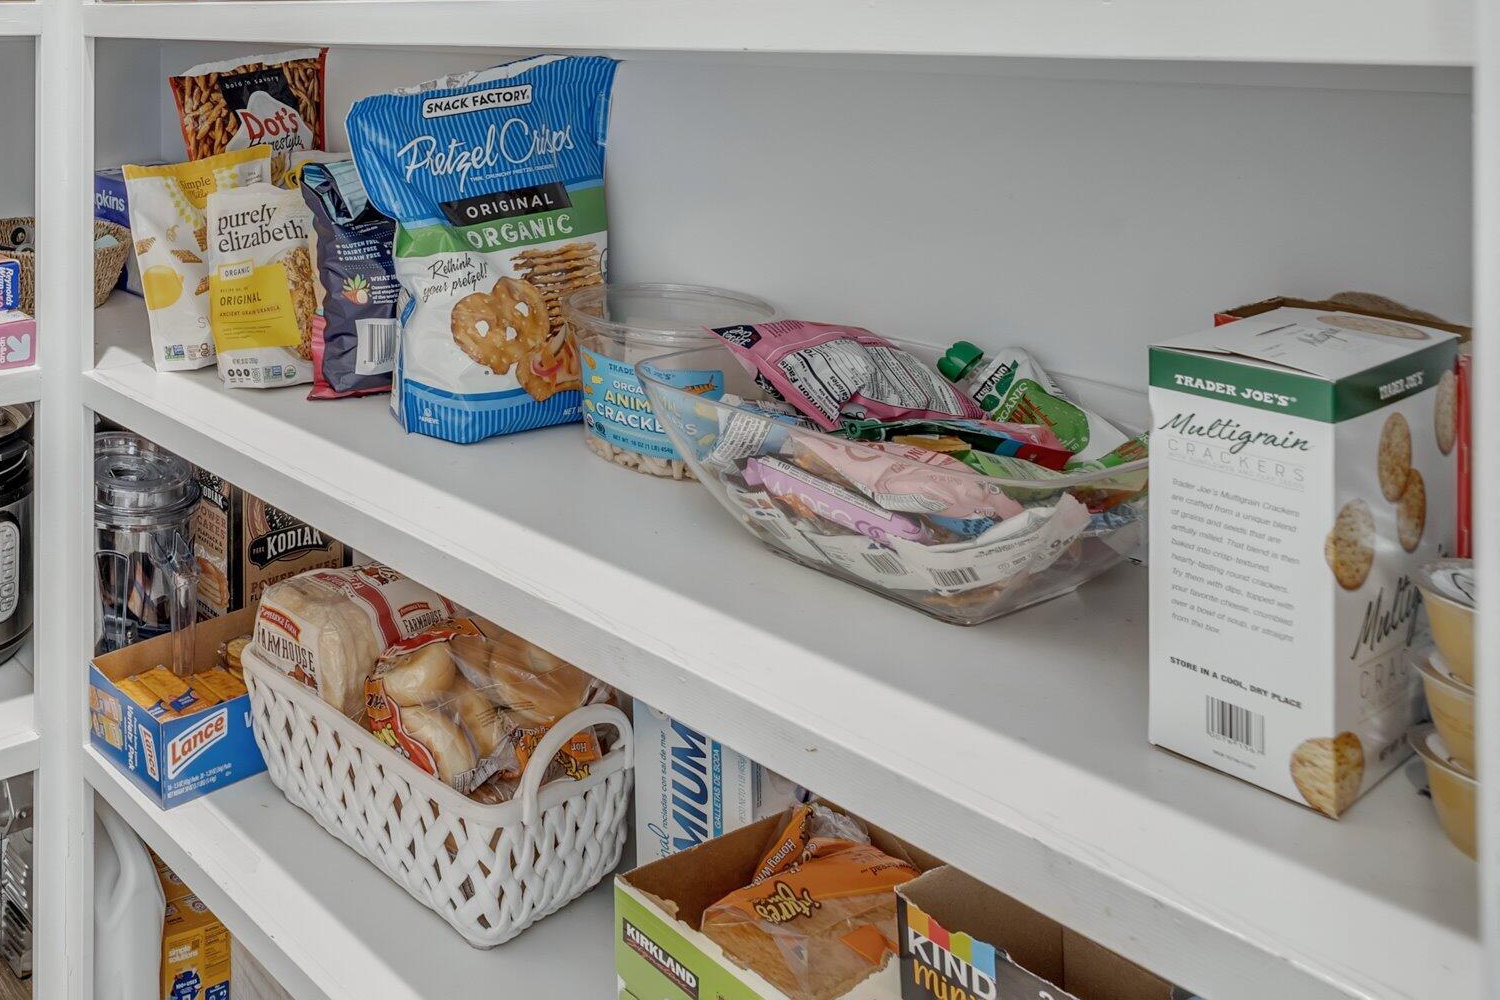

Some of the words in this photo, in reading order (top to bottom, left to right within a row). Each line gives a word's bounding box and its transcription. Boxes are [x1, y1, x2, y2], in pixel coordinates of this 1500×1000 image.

[254, 75, 279, 85] savory
[426, 98, 469, 114] SNACK
[472, 88, 529, 107] FACTORY
[240, 107, 299, 140] Dot's
[397, 123, 499, 193] Pretzel
[499, 117, 575, 168] Crisps
[217, 203, 277, 236] purely
[466, 193, 554, 219] ORIGINAL
[218, 219, 309, 253] elizabeth.
[341, 241, 365, 249] GLUTEN
[466, 213, 574, 249] ORGANIC
[342, 248, 362, 256] DAIRY
[428, 252, 476, 280] Rethink
[5, 267, 14, 306] Reynolds
[224, 266, 250, 278] ORGANIC
[422, 279, 450, 302] your
[450, 263, 488, 296] pretzel!
[219, 292, 262, 306] ORIGINAL
[256, 305, 280, 313] GRANOLA
[1174, 374, 1238, 396] TRADER
[1241, 388, 1291, 407] JOE'S
[1158, 412, 1310, 455] Multigrain
[777, 461, 790, 471] 110
[1167, 438, 1306, 482] CRACKERS
[266, 527, 323, 560] KODIAK
[402, 609, 443, 633] FARMHOUSE
[257, 622, 316, 673] FARMHOUSE
[1170, 656, 1197, 672] STORE
[1200, 667, 1210, 676] IN
[1249, 685, 1268, 697] DRY
[1271, 692, 1303, 709] PLACE
[141, 729, 157, 777] Lance
[170, 714, 225, 765] Lance
[127, 746, 136, 771] Pack
[712, 748, 720, 777] SODA
[712, 779, 720, 791] DE
[712, 793, 722, 829] GALLETAS
[169, 944, 191, 957] simple
[169, 950, 198, 964] solutions
[625, 922, 698, 989] KIRKLAND
[907, 926, 998, 1000] KIND
